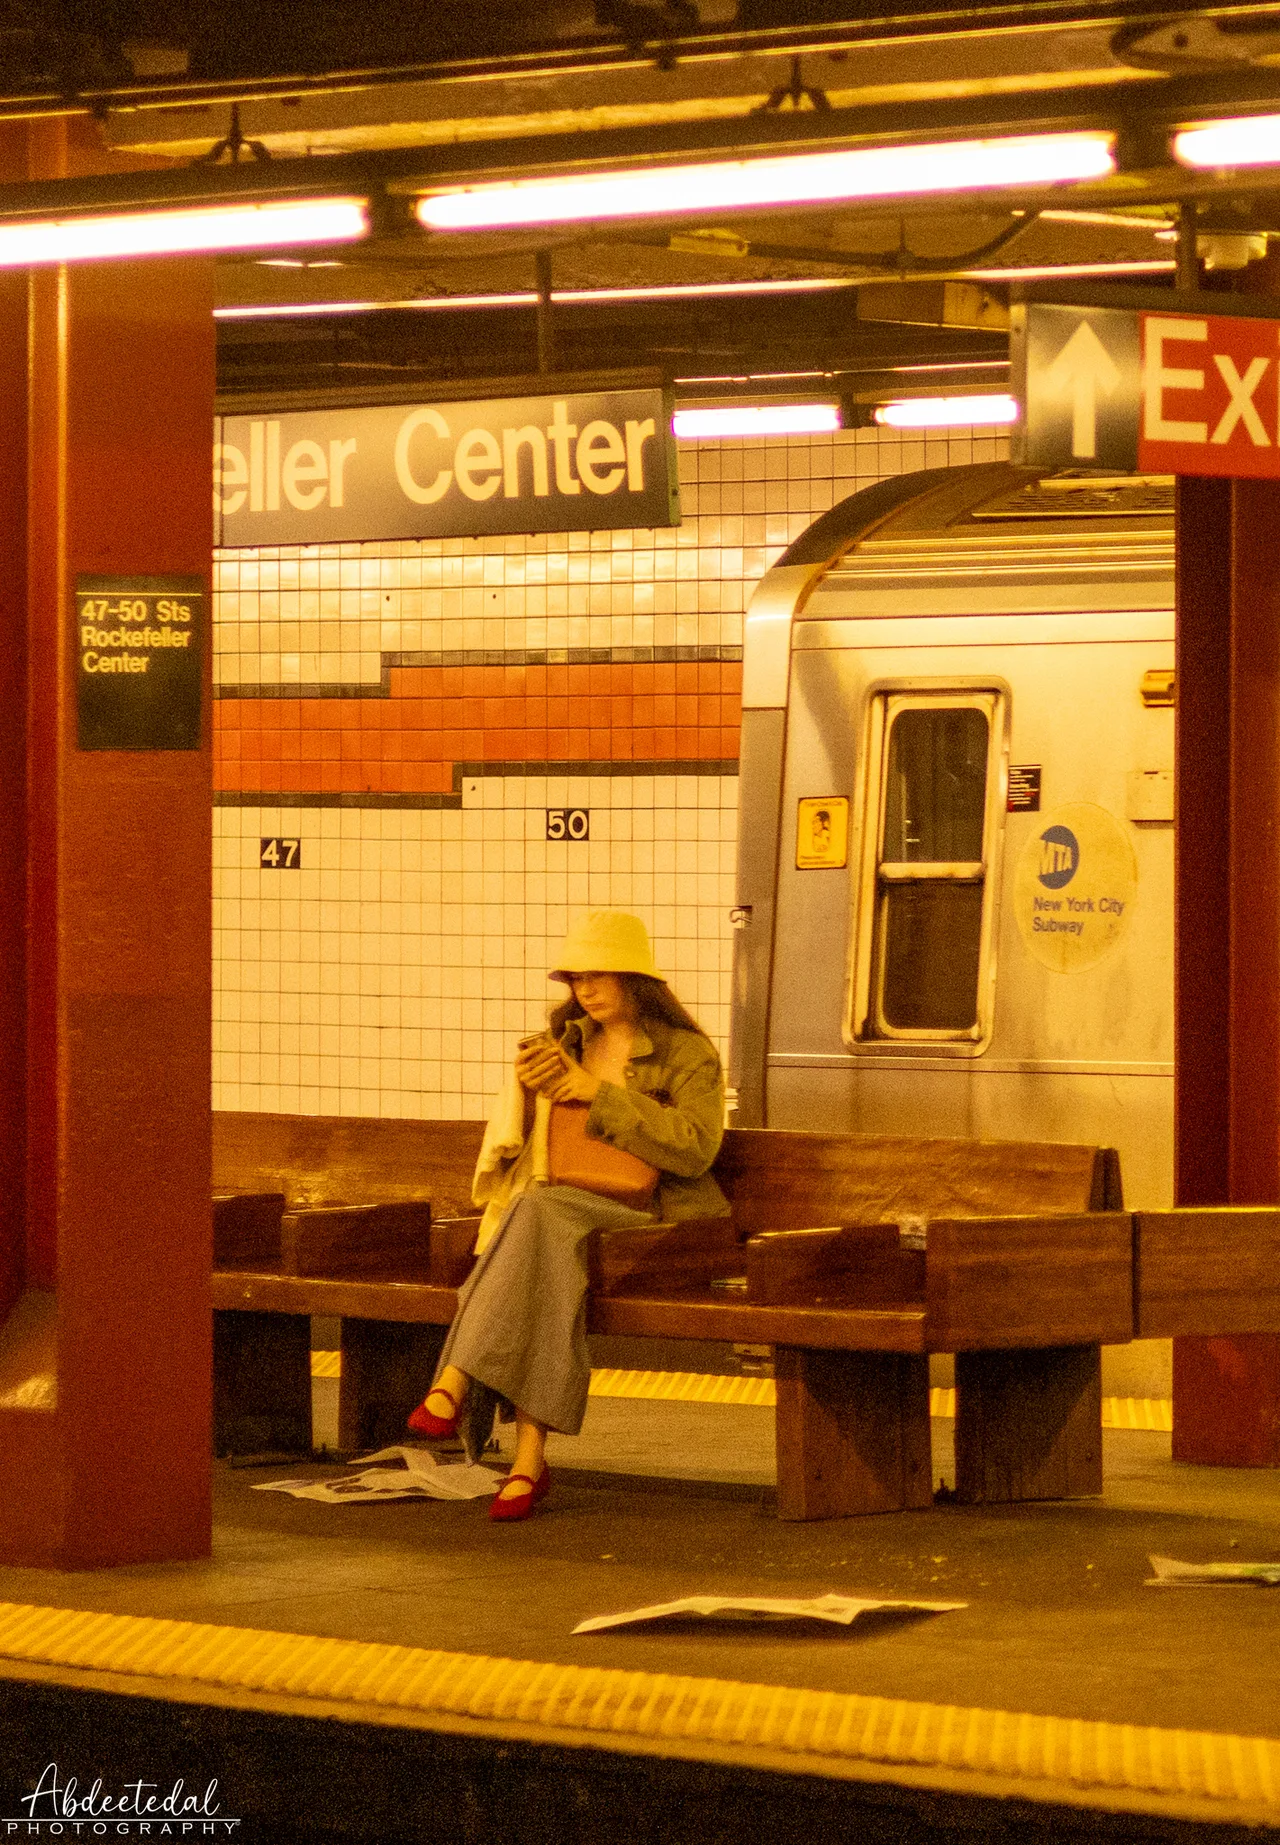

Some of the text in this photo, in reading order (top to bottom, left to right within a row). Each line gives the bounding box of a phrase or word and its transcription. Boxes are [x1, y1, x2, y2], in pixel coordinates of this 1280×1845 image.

[1144, 316, 1280, 447] Ex
[394, 400, 656, 505] Center
[81, 600, 191, 622] 47-50 Sts
[81, 625, 191, 647] Rockefeller
[82, 650, 149, 673] Center
[548, 810, 588, 839] 50
[261, 840, 298, 867] 47
[1033, 896, 1125, 917] New York City
[1032, 916, 1084, 936] Subway
